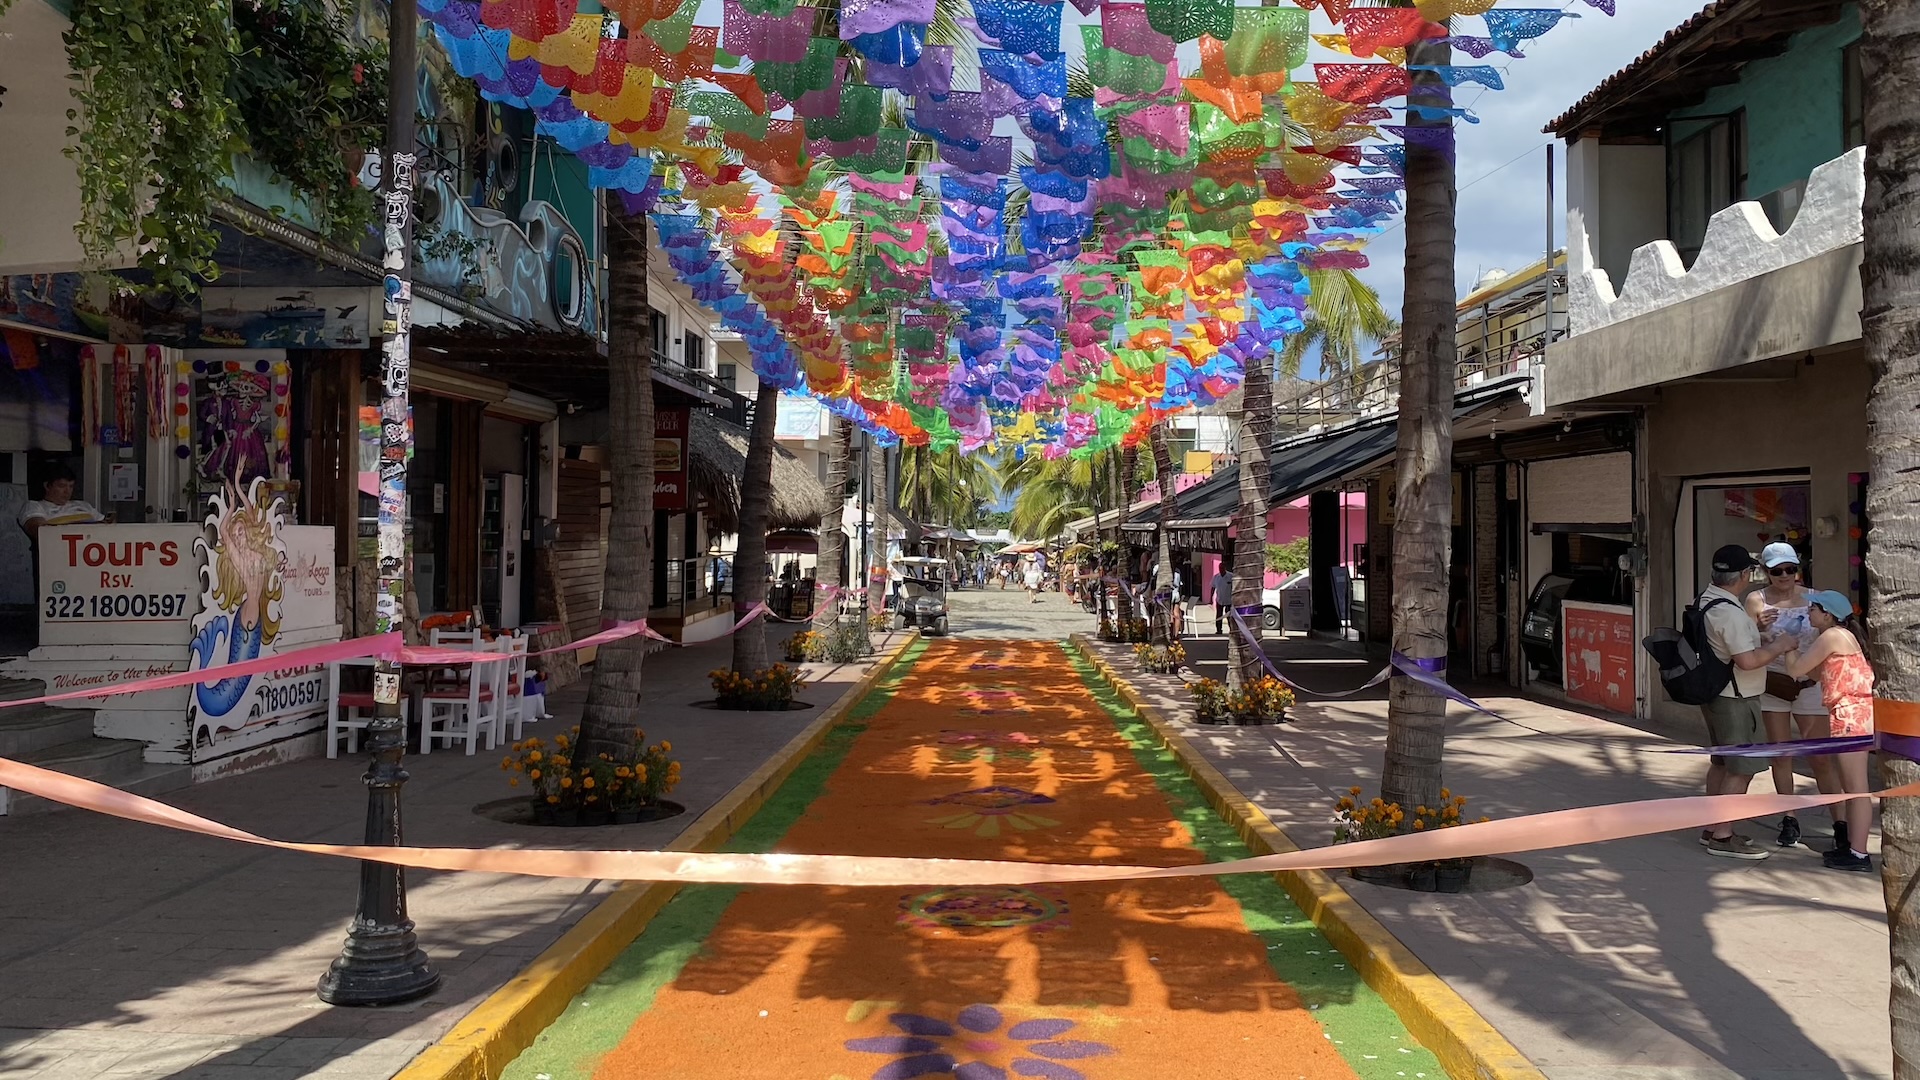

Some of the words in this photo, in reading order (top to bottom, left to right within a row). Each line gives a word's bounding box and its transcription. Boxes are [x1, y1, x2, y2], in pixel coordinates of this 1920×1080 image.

[654, 411, 679, 421] LASSIC
[656, 421, 679, 431] RGER
[61, 534, 179, 567] Tours
[100, 571, 134, 588] Rsv.
[53, 673, 105, 689] Welcome
[107, 670, 120, 683] to
[123, 667, 143, 680] the
[145, 662, 174, 677] best
